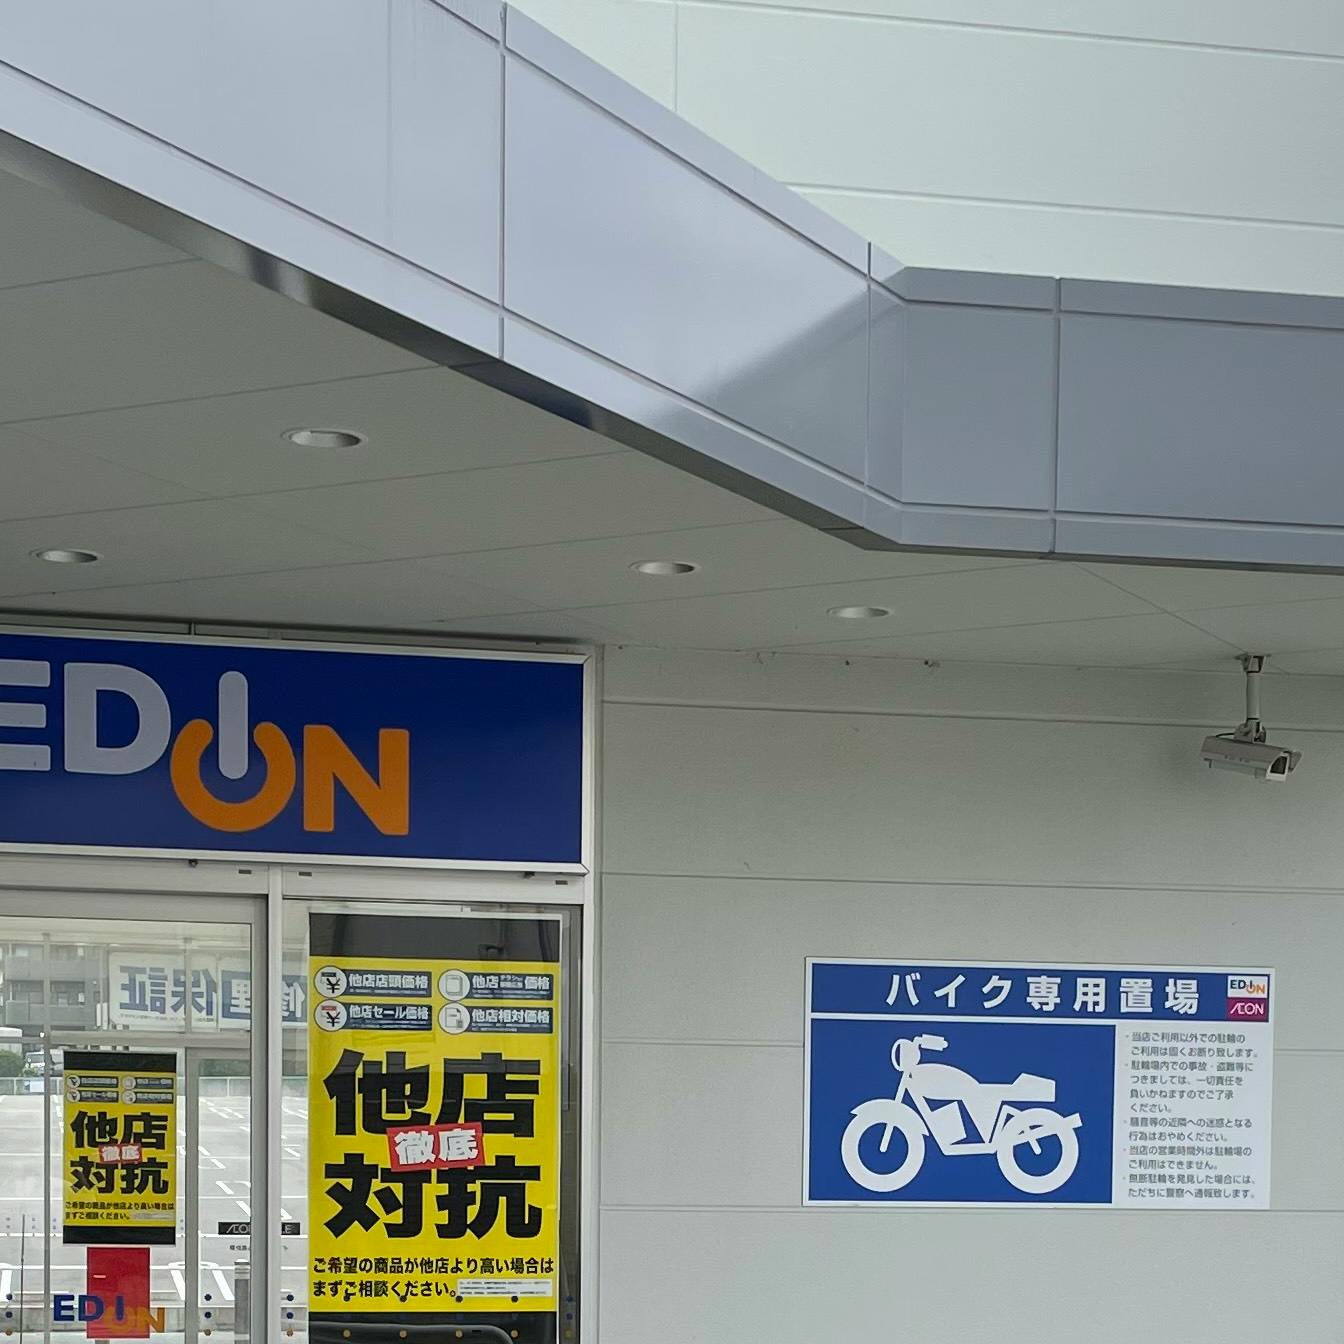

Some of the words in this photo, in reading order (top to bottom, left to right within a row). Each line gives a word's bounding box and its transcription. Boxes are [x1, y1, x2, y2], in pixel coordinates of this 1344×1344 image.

[349, 973, 429, 989] 他店店頭価格
[472, 975, 499, 989] 他店
[525, 976, 550, 990] 価格
[1230, 979, 1266, 995] EDION
[885, 972, 1199, 1016] バイク専用置場
[349, 1005, 429, 1020] 他店セール価格
[323, 1048, 541, 1138] 他店
[1130, 1089, 1234, 1100] 負いかねますのでご了承
[1130, 1103, 1172, 1113] ください。
[70, 1110, 168, 1149] 他店
[1129, 1131, 1228, 1142] 行為はおやめください。
[394, 1128, 479, 1165] 徹底
[1128, 1159, 1218, 1170] ご利用はできません。
[70, 1156, 169, 1195] 対抗
[324, 1153, 543, 1240] 対抗
[312, 1257, 554, 1275] ご希望の商品が他店より高い場合は
[312, 1280, 456, 1298] まずご相談ください。
[53, 1294, 166, 1333] EDION
